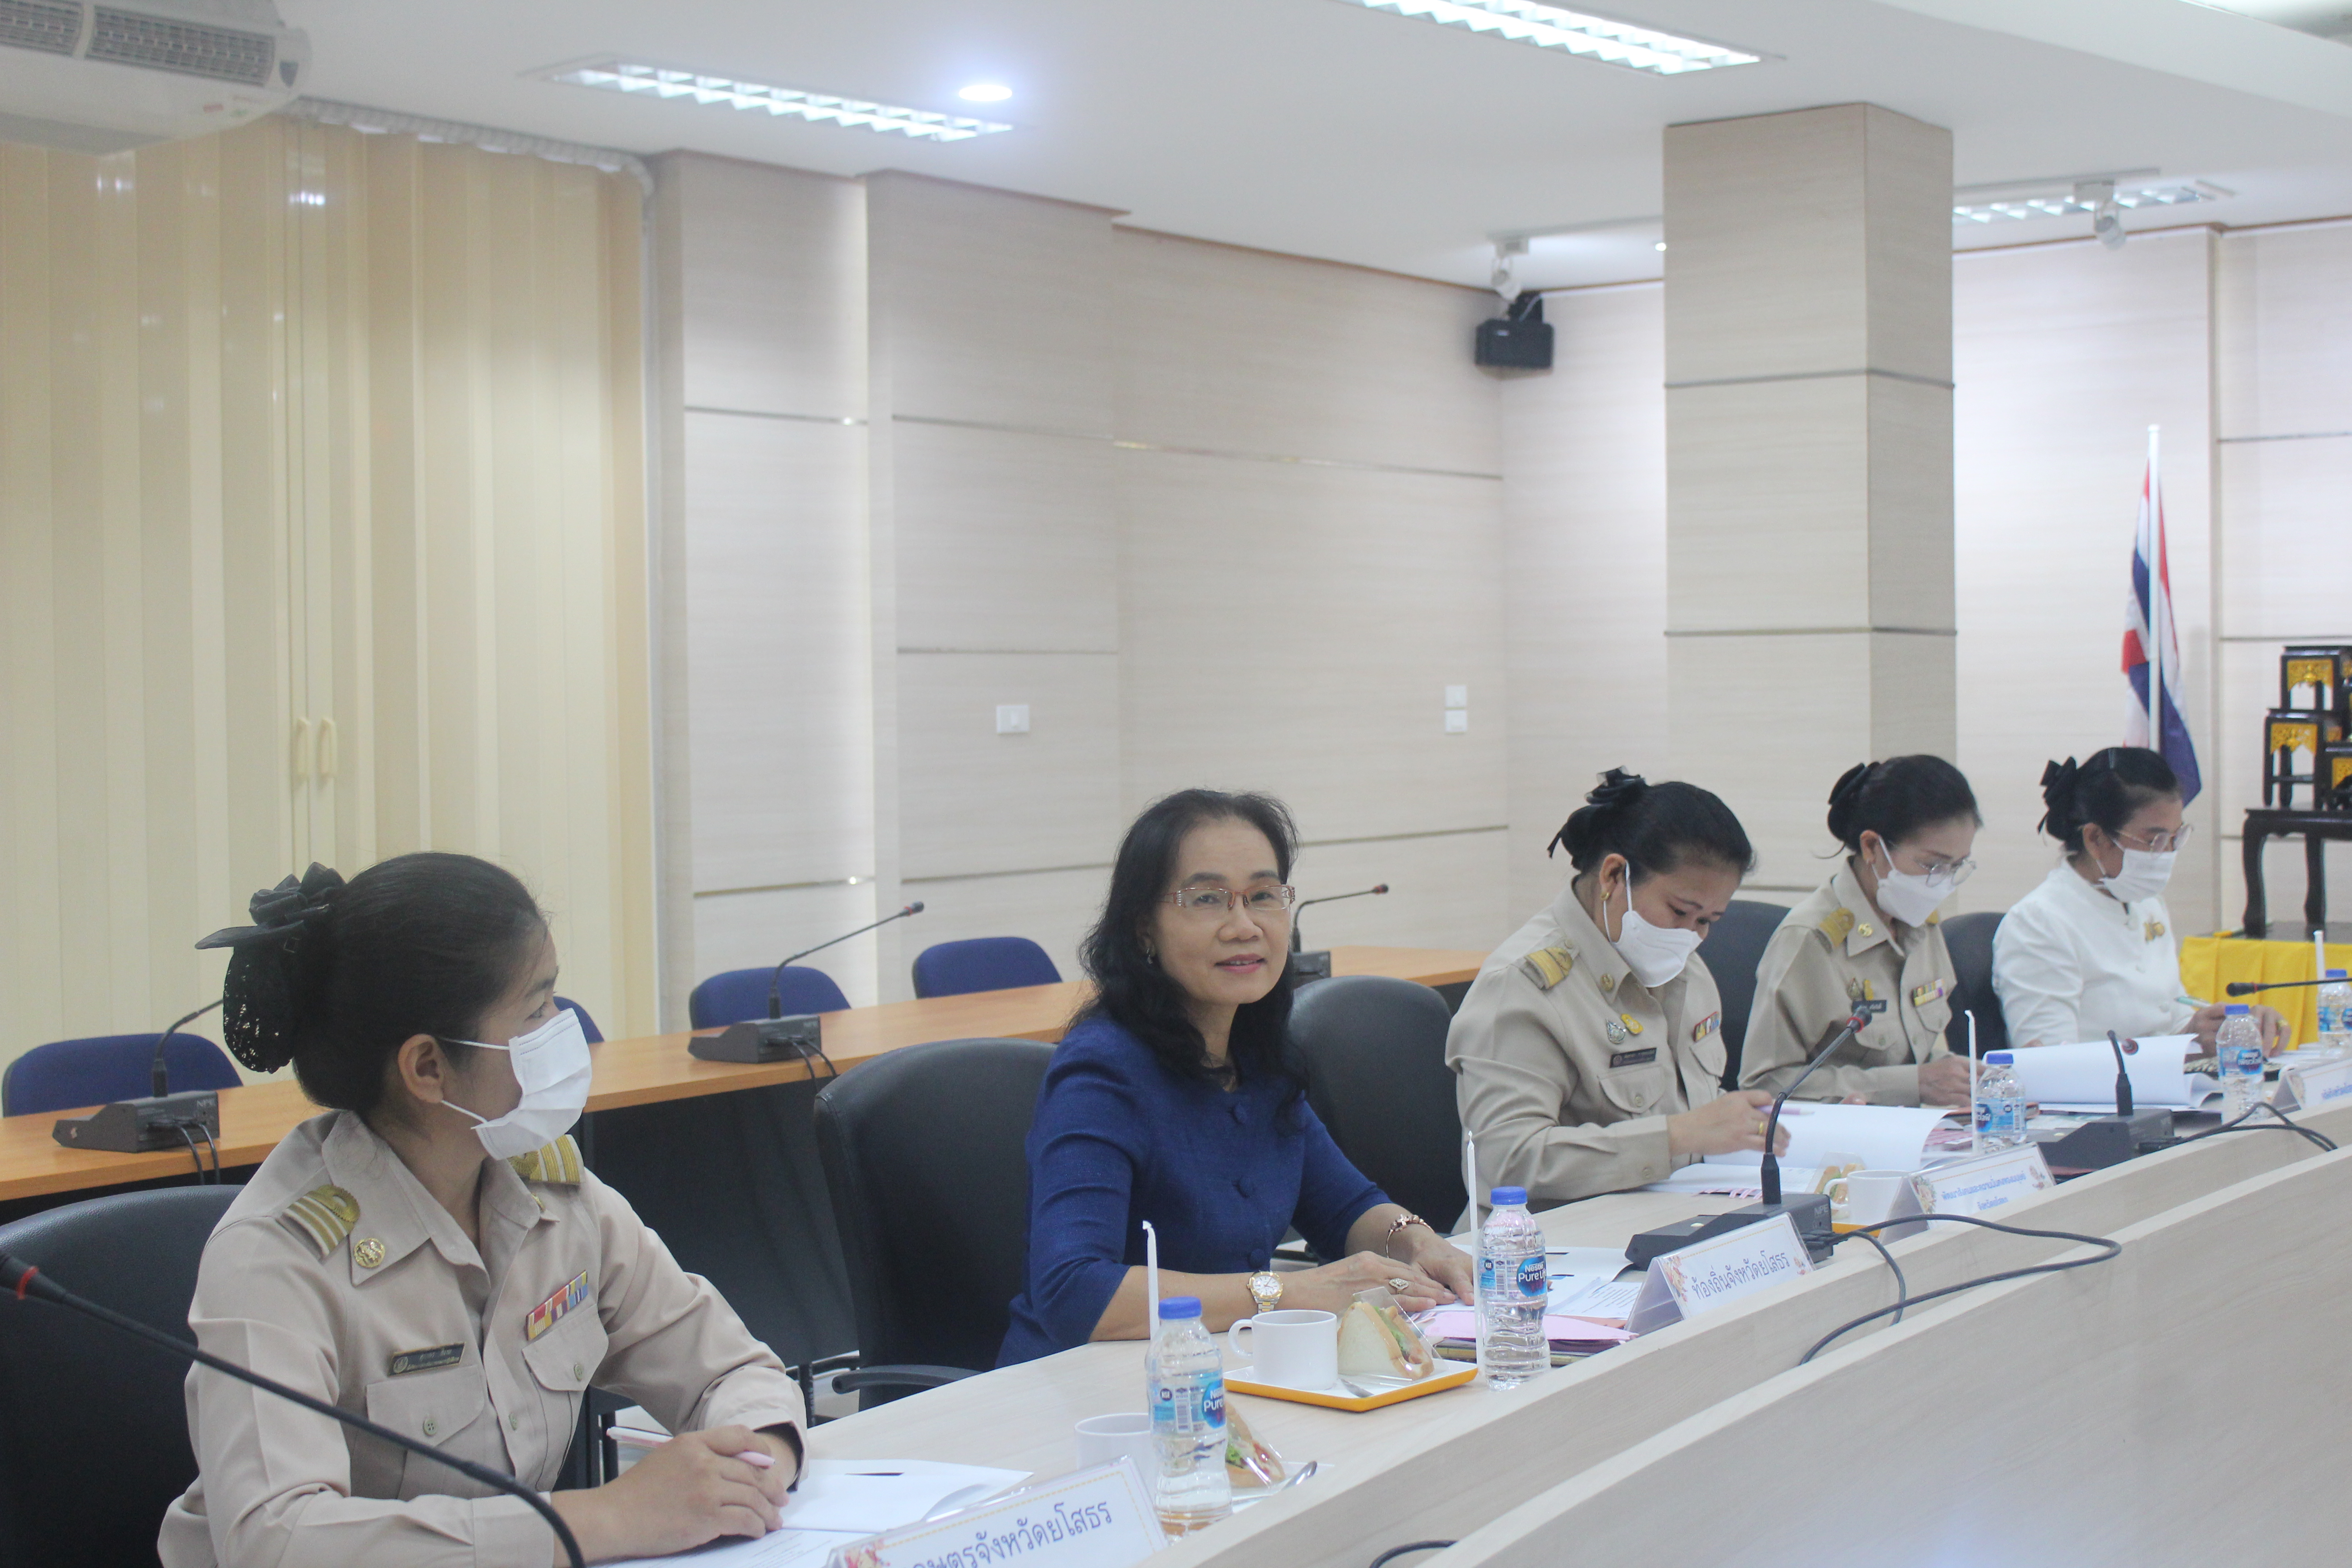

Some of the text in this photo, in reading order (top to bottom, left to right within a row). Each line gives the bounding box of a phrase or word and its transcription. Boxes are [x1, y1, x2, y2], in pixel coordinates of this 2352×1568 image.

[1518, 1272, 1539, 1283] Pure
[1691, 1250, 1790, 1299] ท้องถิ่นจังหวัดยโสธร
[1204, 1398, 1223, 1412] Pure
